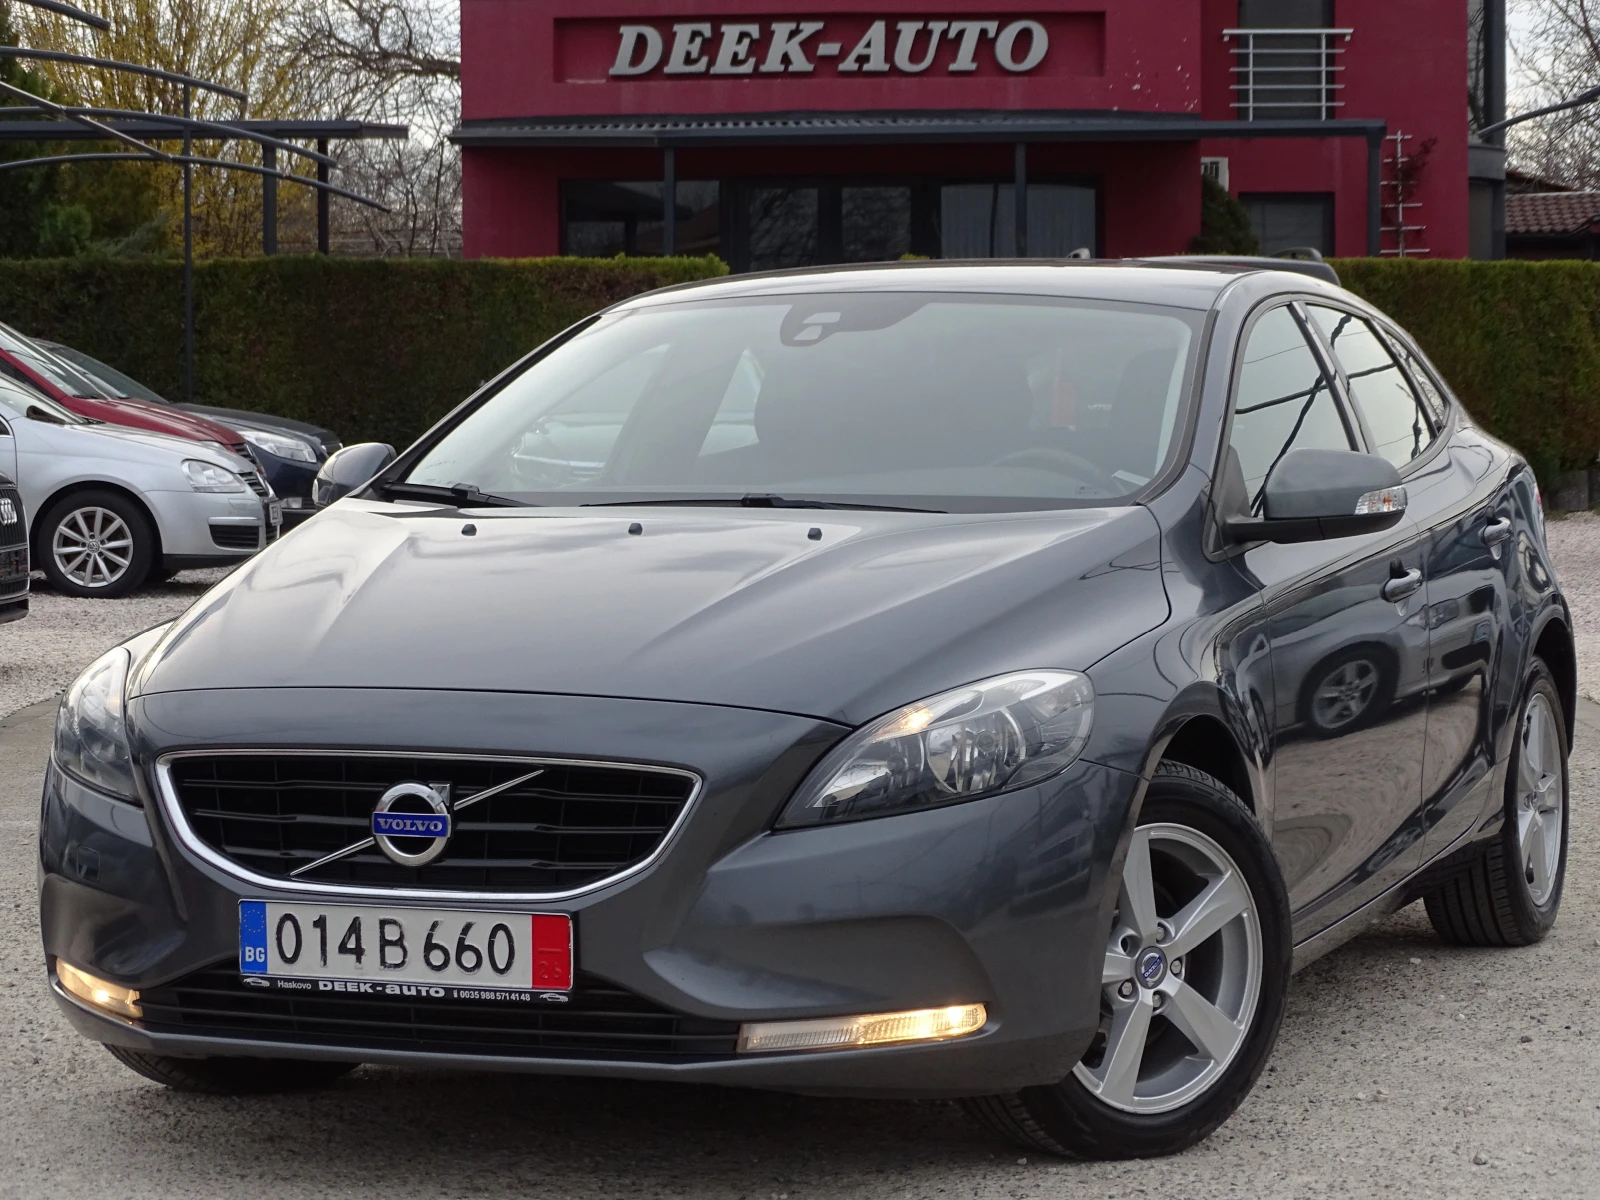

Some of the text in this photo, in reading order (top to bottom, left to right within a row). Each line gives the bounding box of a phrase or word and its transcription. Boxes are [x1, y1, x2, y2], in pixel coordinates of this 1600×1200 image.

[609, 20, 1049, 76] DEEK-AUTO
[377, 818, 443, 832] VOLVO
[245, 946, 266, 963] BG
[277, 980, 312, 990] Haskovo
